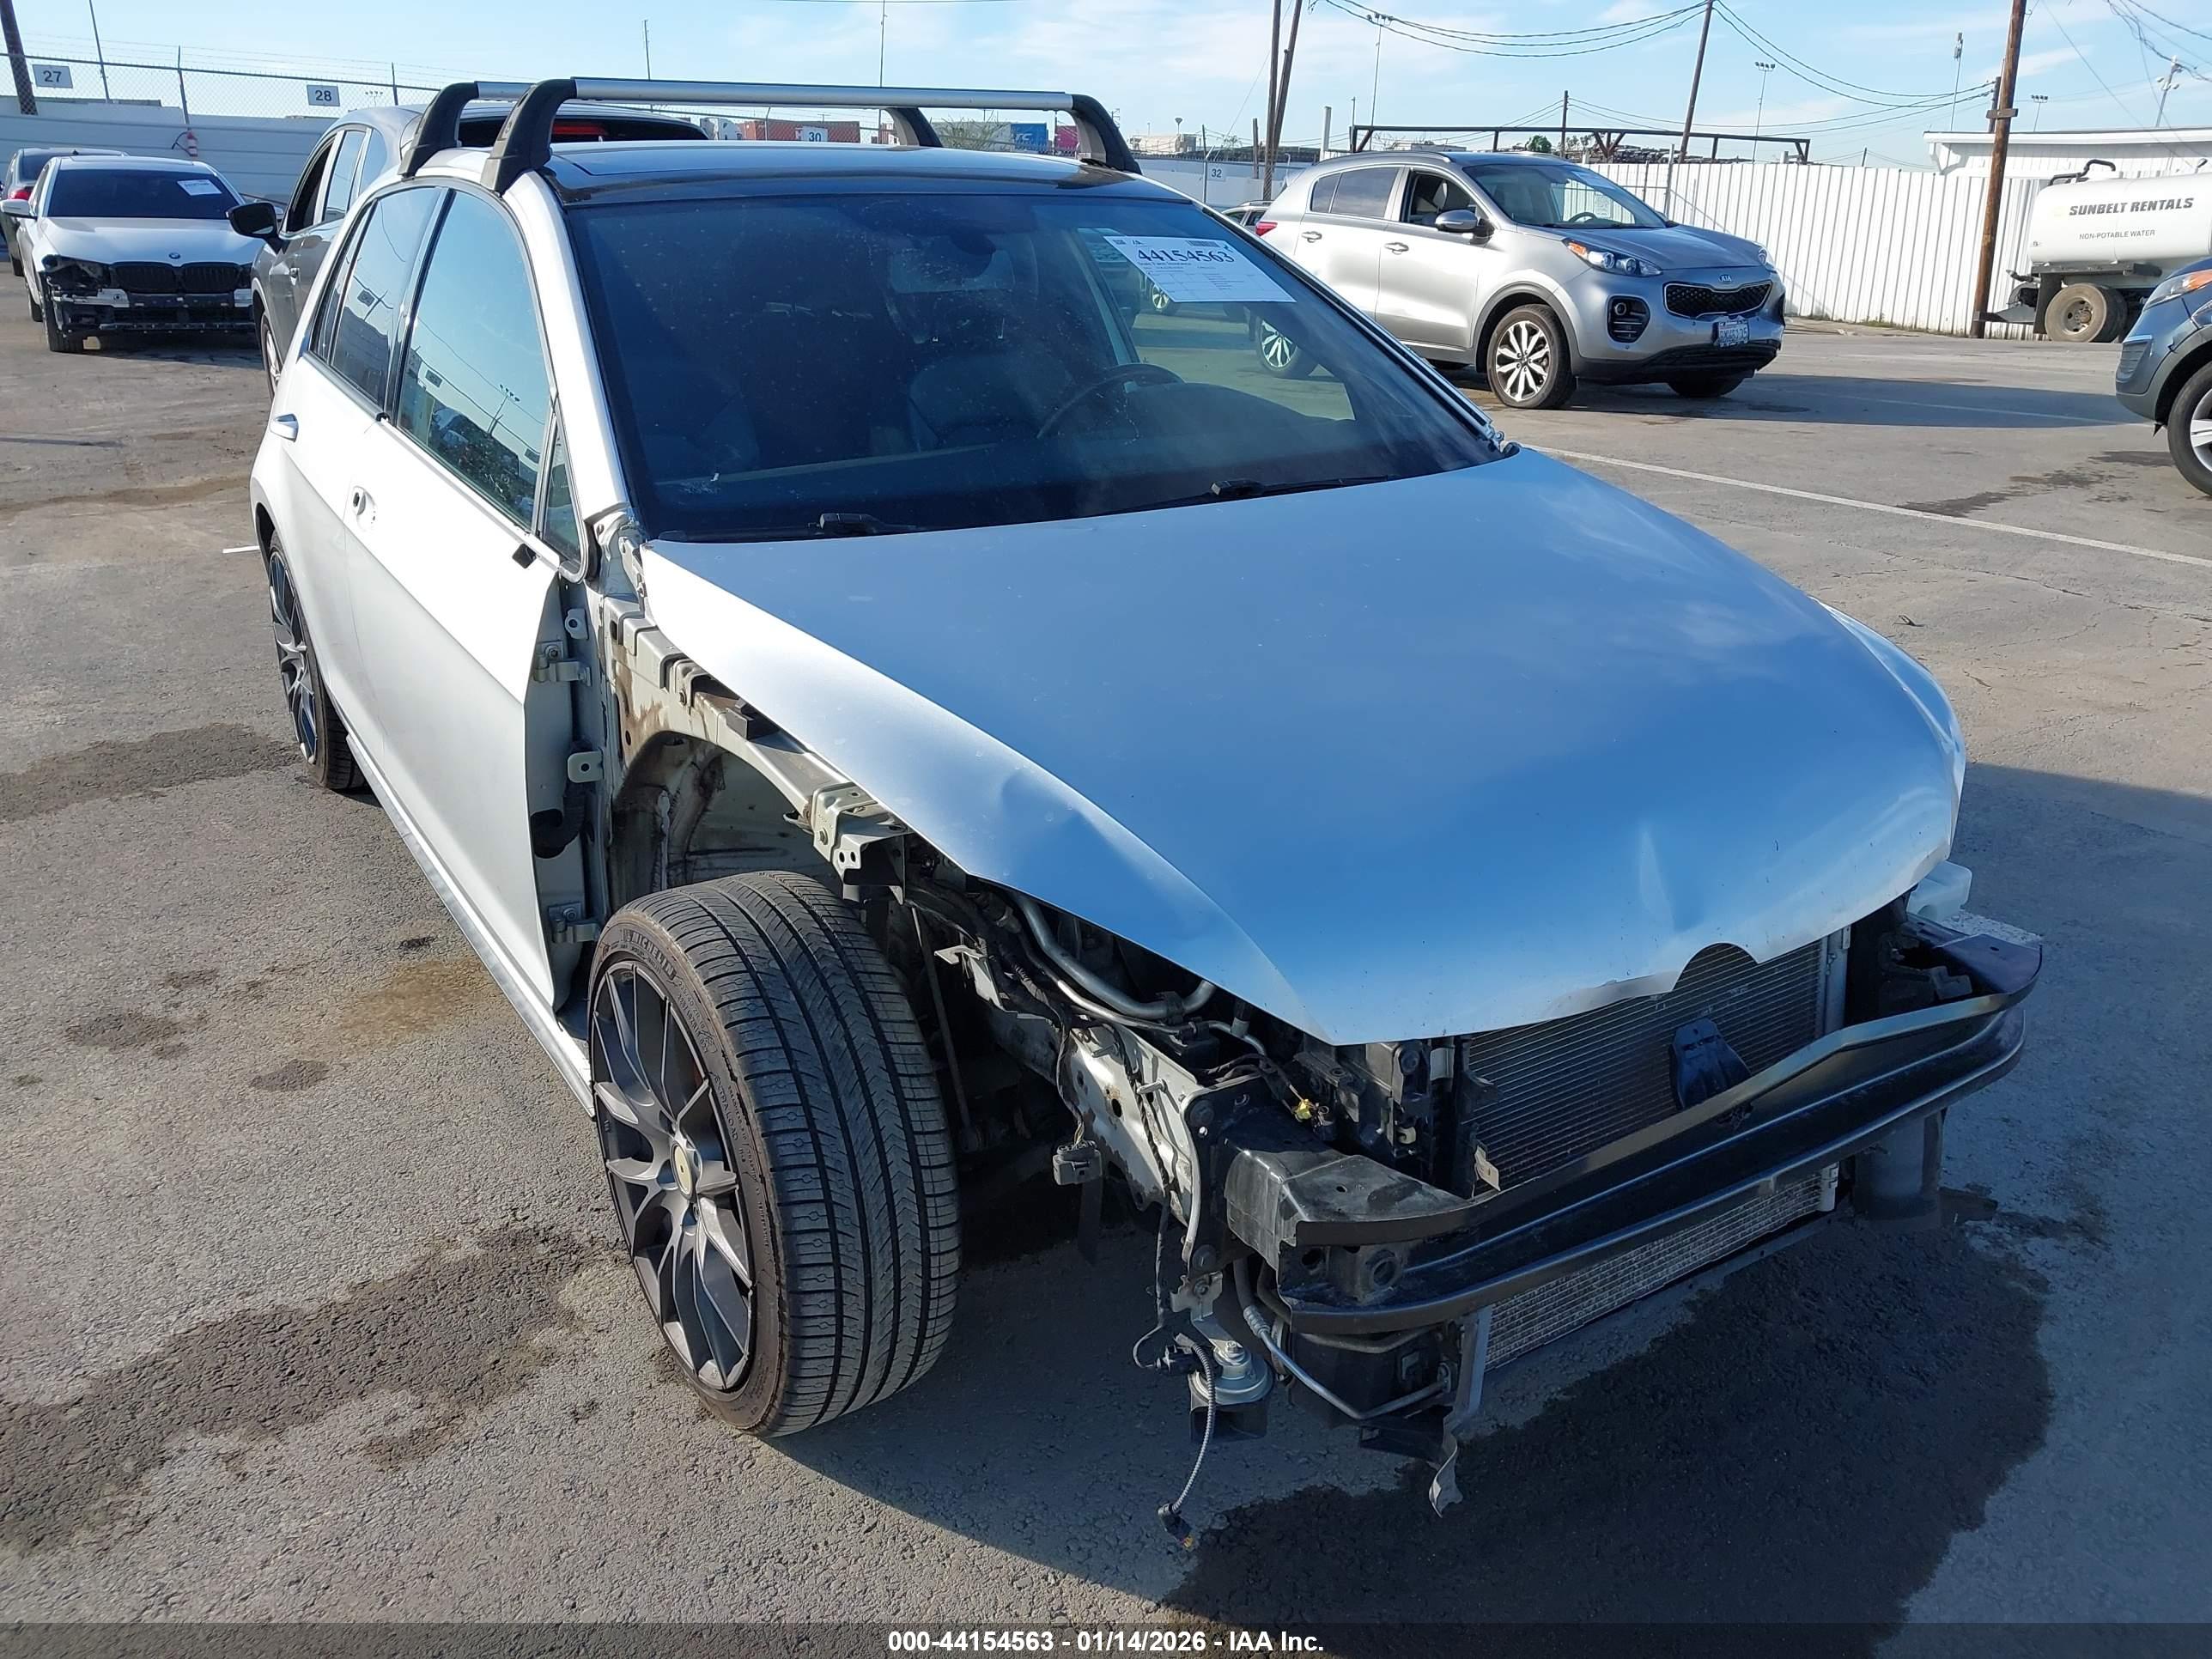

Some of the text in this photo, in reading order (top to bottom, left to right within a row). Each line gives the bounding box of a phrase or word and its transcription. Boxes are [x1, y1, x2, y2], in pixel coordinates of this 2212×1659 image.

[44, 70, 63, 84] 27
[314, 89, 333, 102] 28
[808, 131, 822, 142] 30
[1211, 168, 1223, 178] 32
[2069, 198, 2195, 216] SUNBELT RENTALS
[2079, 229, 2155, 240] NON-POTABLE WATER
[1138, 248, 1236, 263] 44154563
[631, 930, 677, 981] MICHELIN
